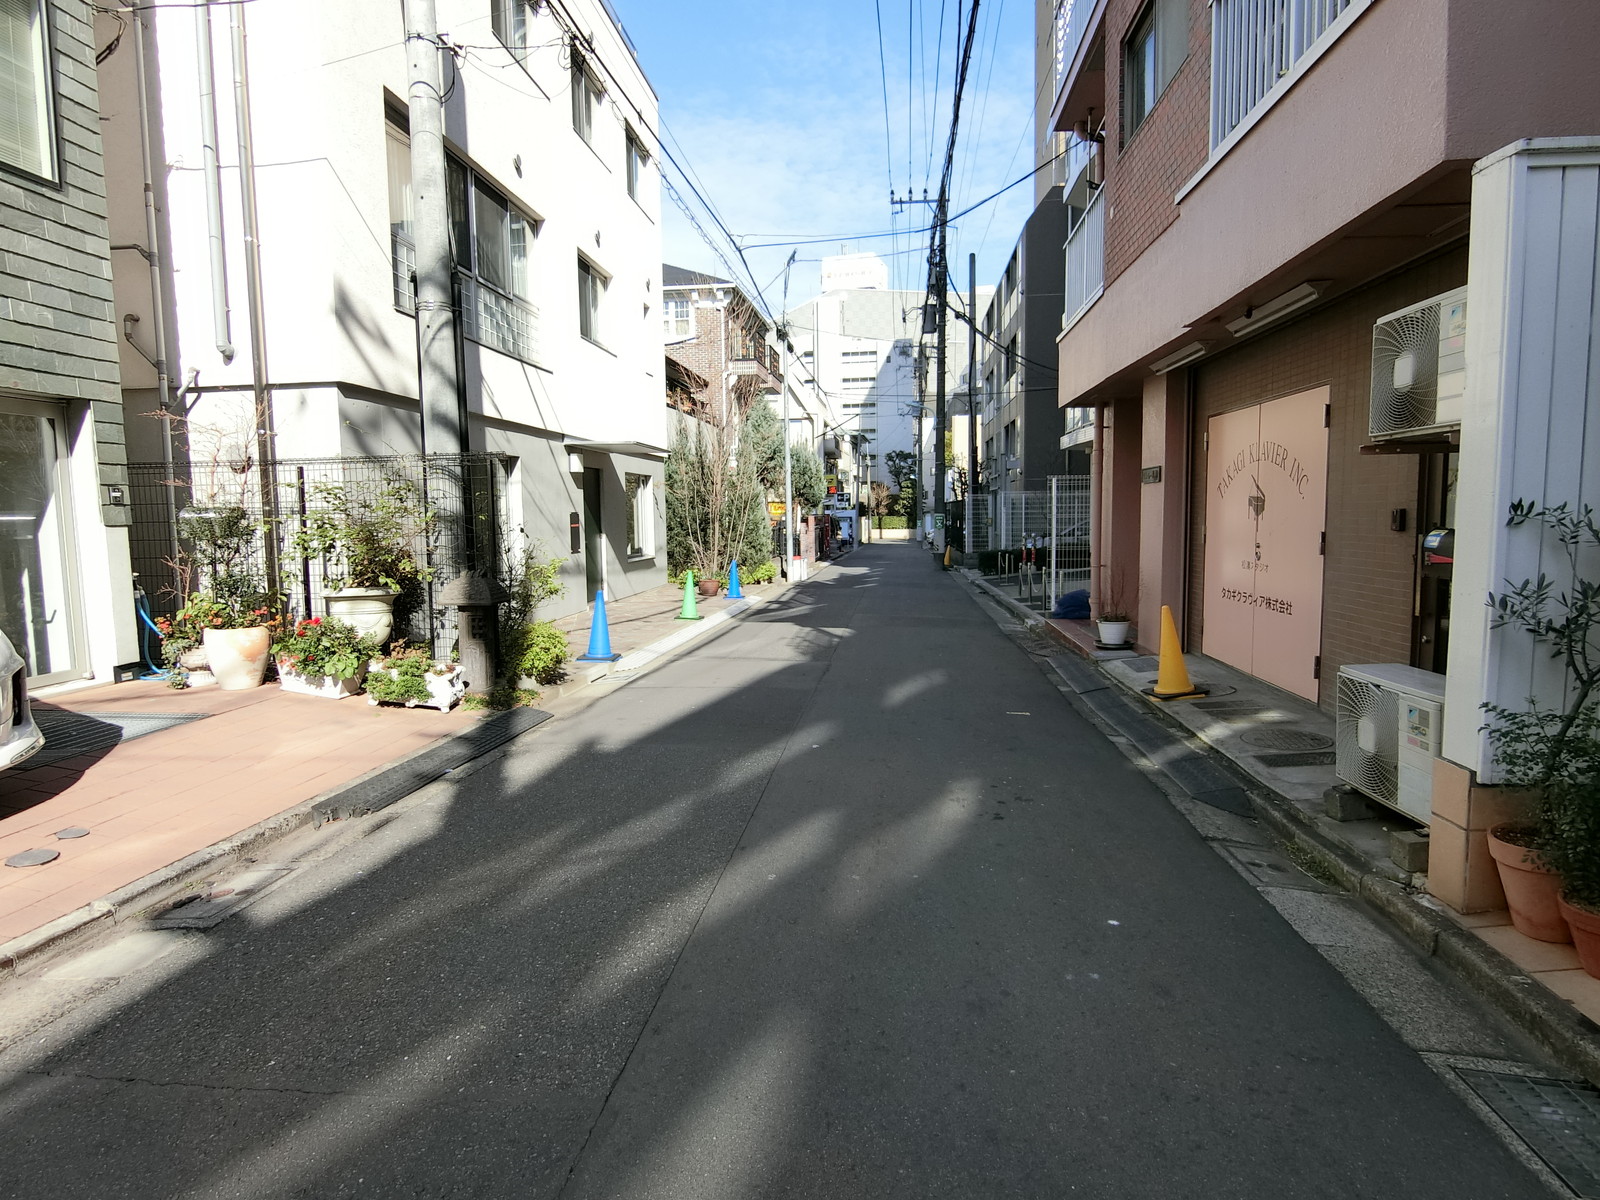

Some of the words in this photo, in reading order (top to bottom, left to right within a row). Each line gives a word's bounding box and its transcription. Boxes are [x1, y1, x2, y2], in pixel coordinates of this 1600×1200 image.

[1217, 449, 1246, 499] TAKAGI
[1249, 440, 1289, 471] KLAVIER
[1288, 457, 1309, 499] INC.
